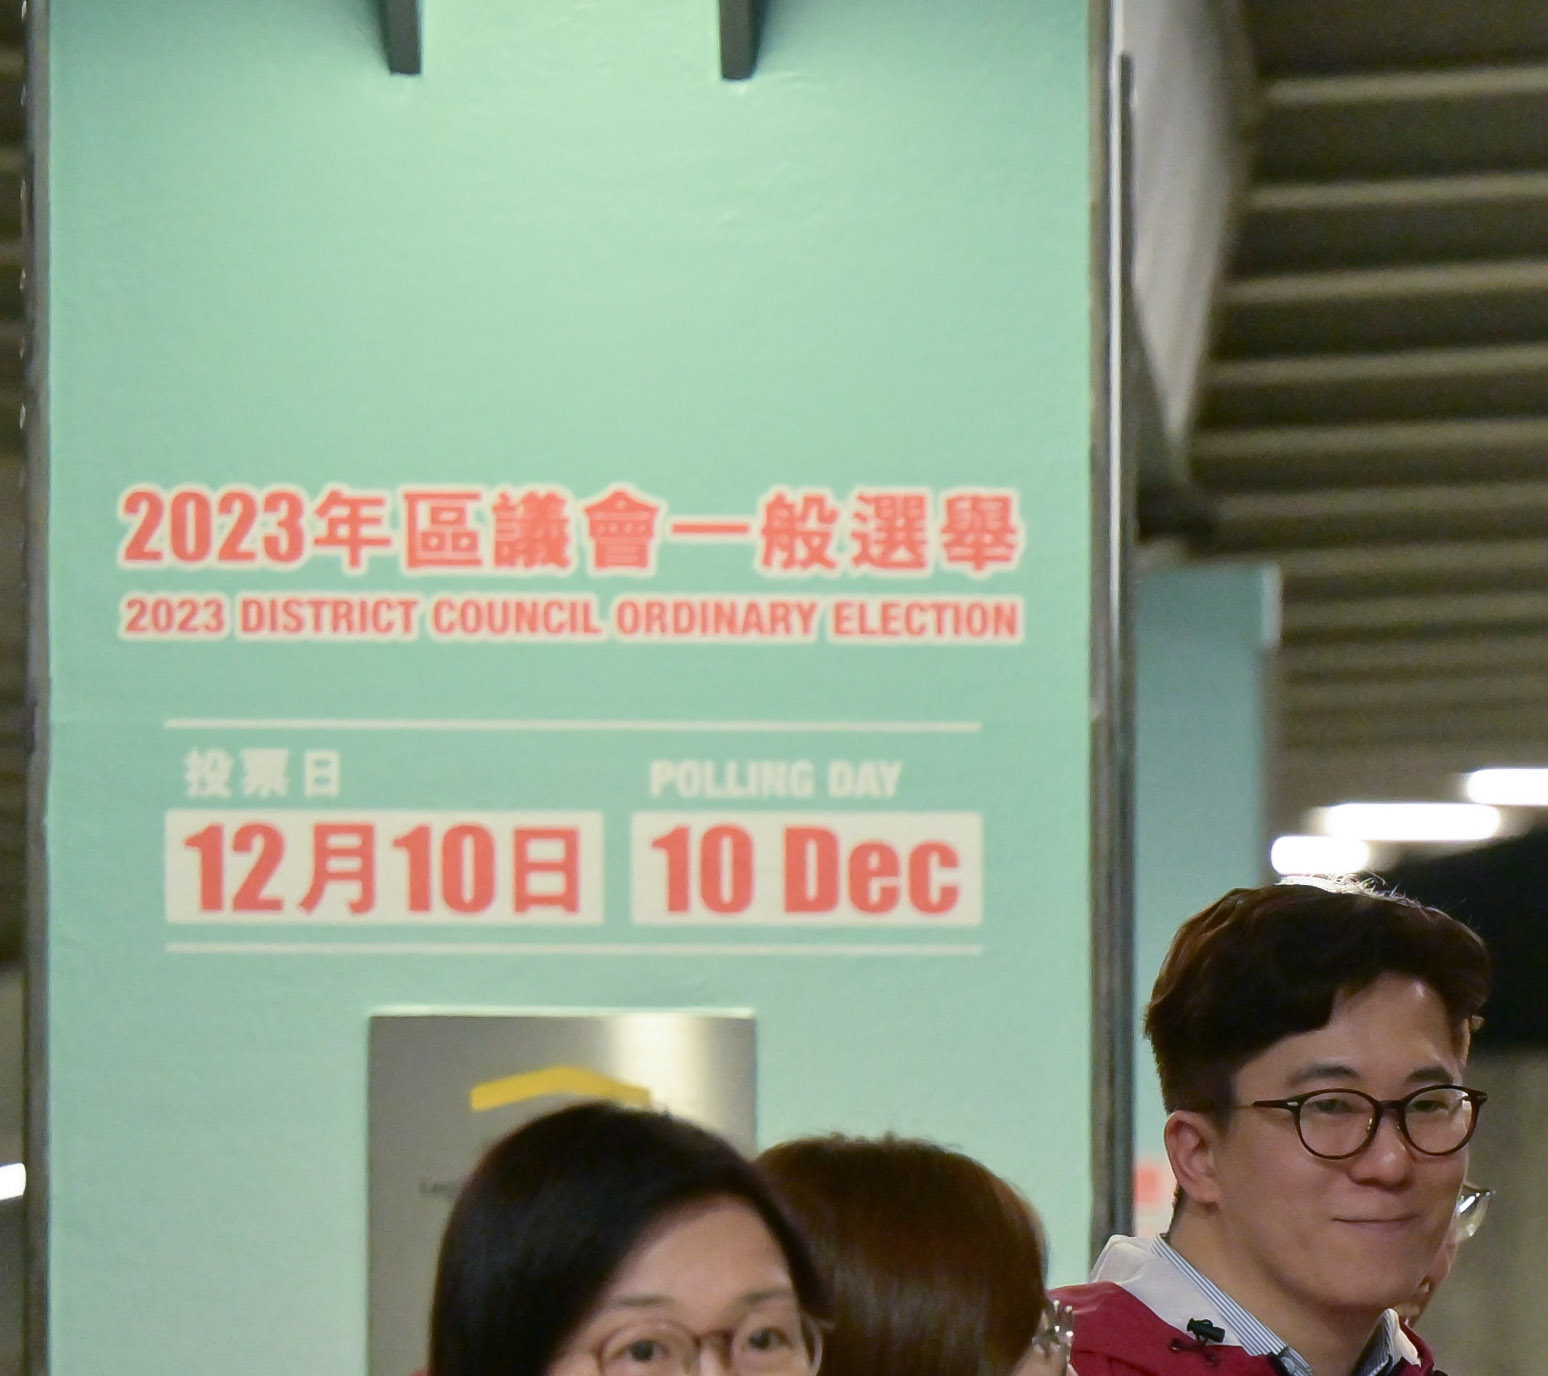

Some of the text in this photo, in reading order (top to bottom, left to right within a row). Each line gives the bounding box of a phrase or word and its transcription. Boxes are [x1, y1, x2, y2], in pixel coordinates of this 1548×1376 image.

[122, 488, 1019, 573] 2023年區議會一般選舉
[125, 598, 1019, 637] 2023 DISTRICT COUNCIL ORDINARY ELECTION
[184, 747, 341, 799] 投票日
[649, 759, 904, 799] POLLING DAY
[184, 821, 581, 915] 12月10日
[650, 822, 961, 915] 10 Dec
